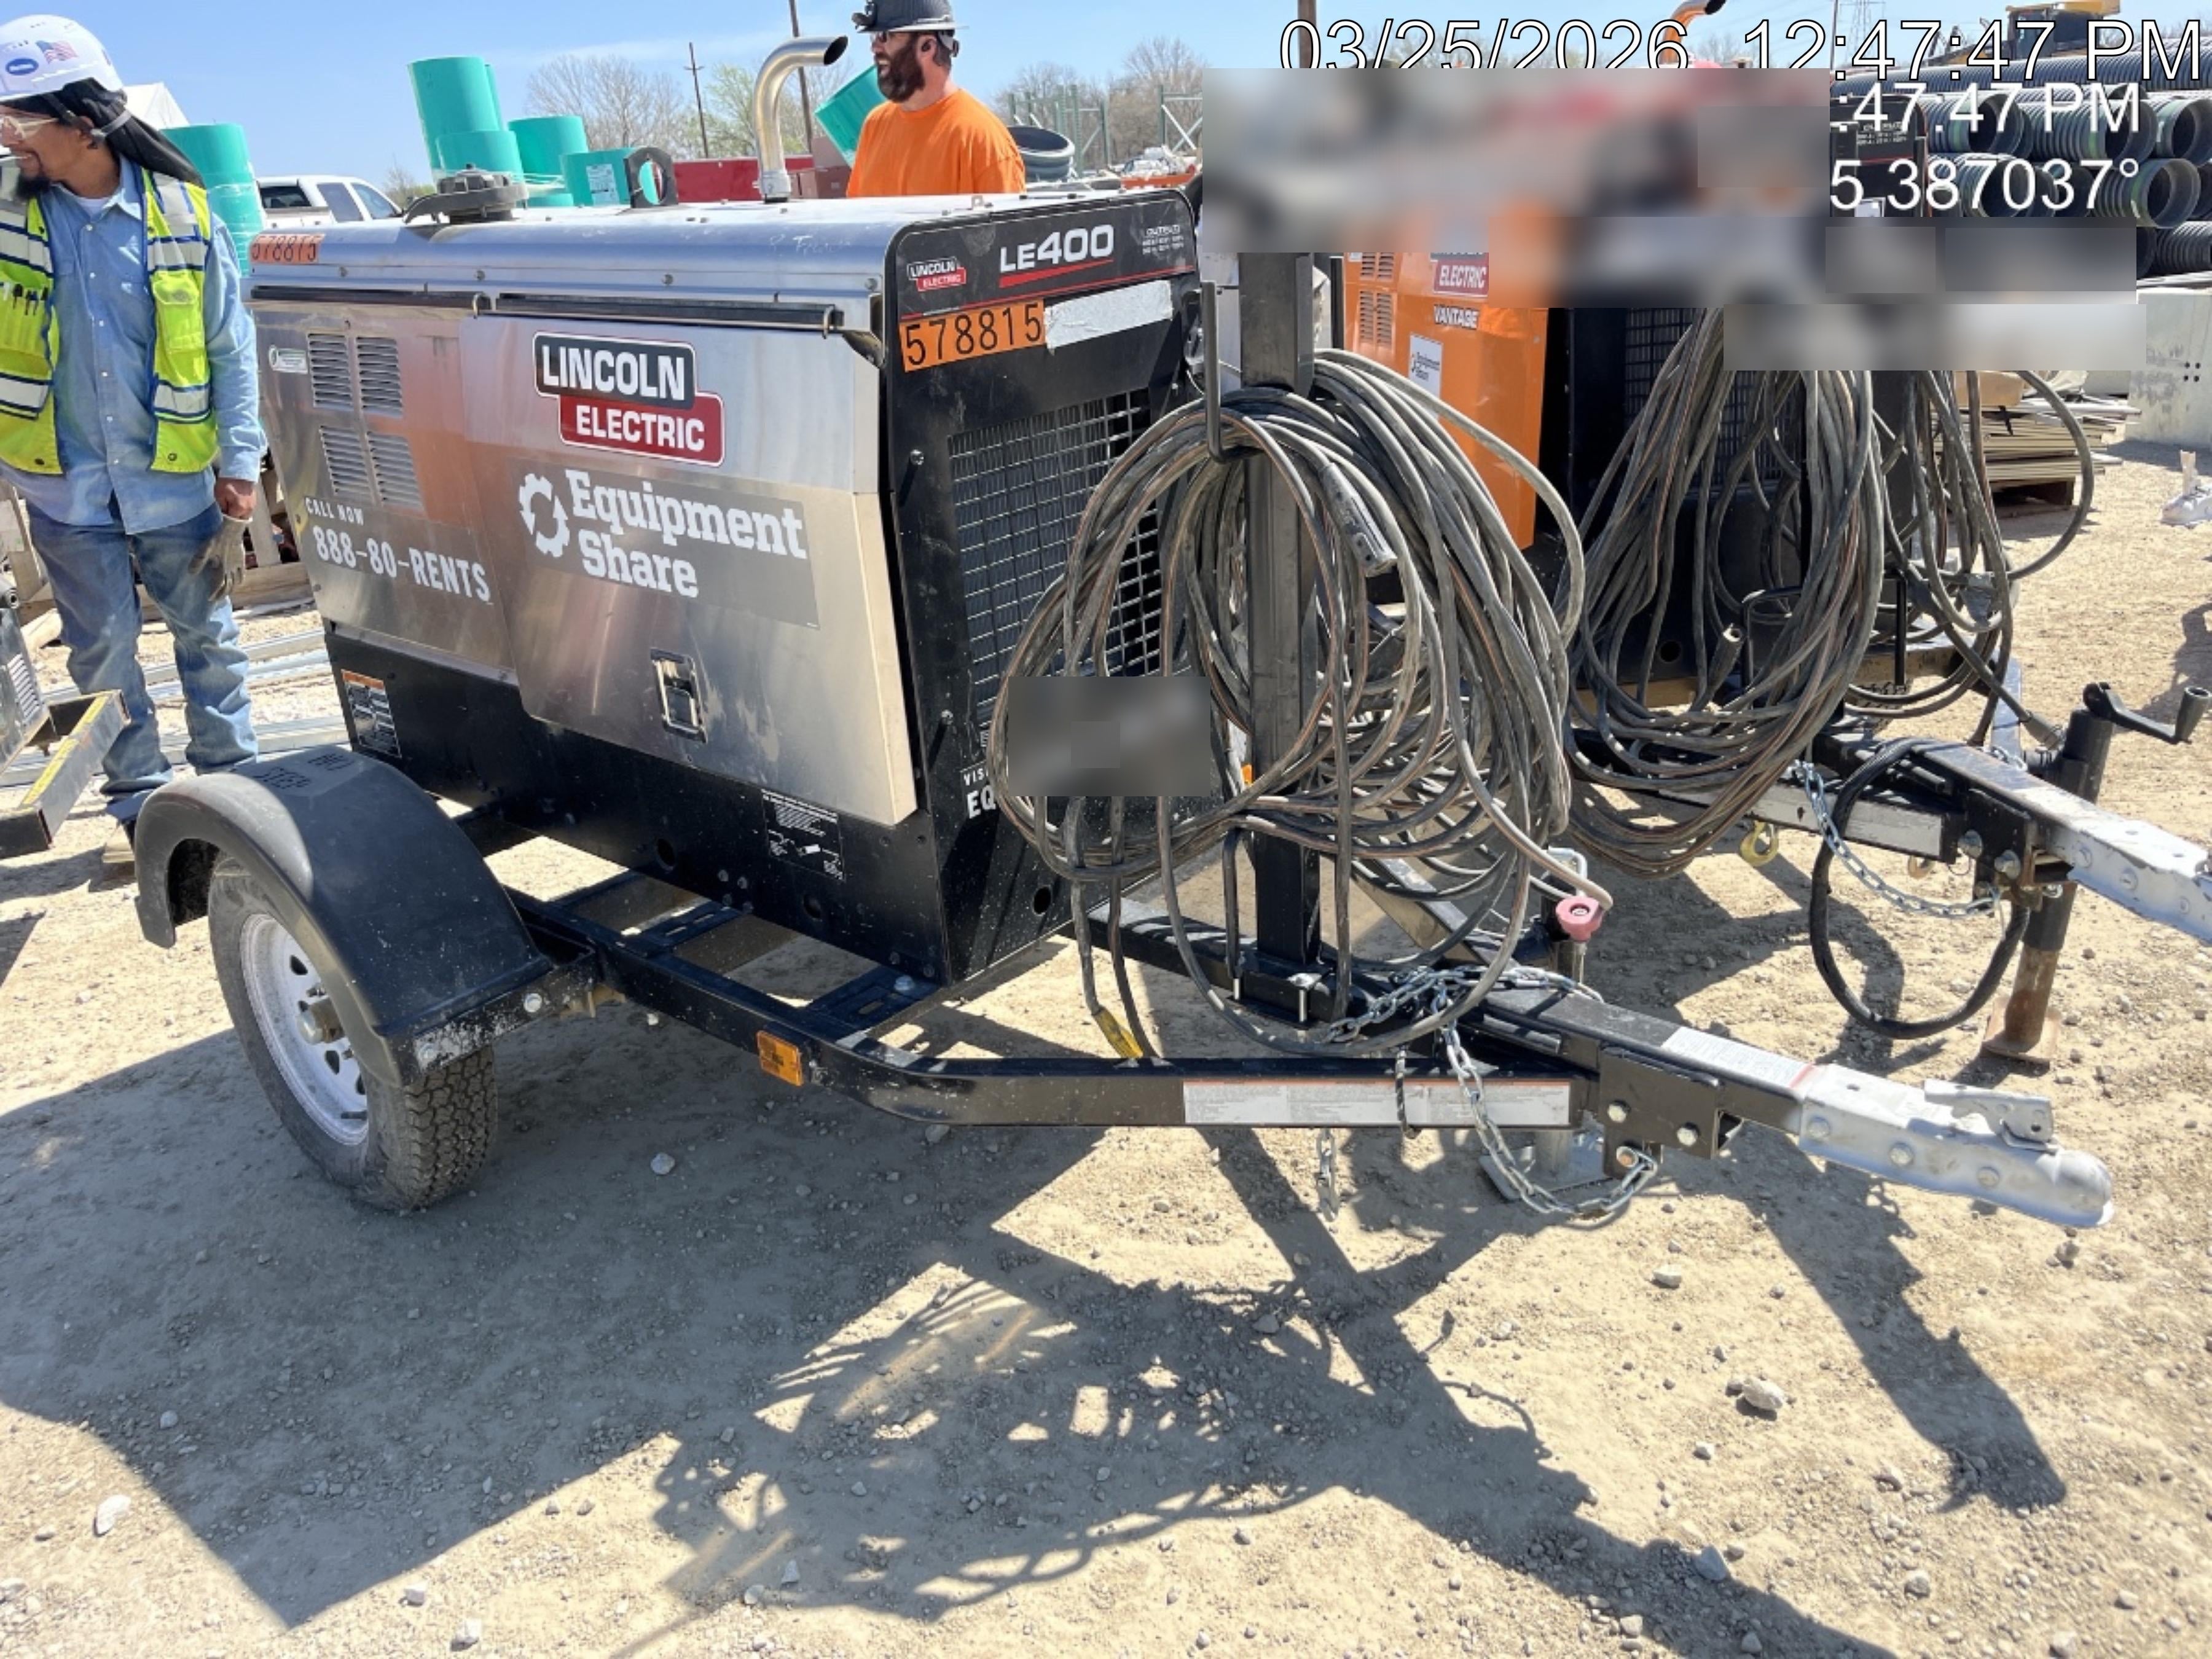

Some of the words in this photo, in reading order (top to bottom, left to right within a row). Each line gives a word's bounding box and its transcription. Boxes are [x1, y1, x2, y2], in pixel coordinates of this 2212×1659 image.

[910, 261, 956, 278] LINCOLN
[999, 223, 1115, 273] LE400
[922, 274, 961, 288] ELECTRIC
[1438, 264, 1487, 289] ELECTRIC
[905, 304, 1041, 366] 578815
[1433, 304, 1480, 330] VANTAGE
[541, 345, 685, 401] LINCOLN
[576, 404, 705, 452] ELECTRIC
[305, 496, 335, 519] CALL
[337, 503, 364, 526] NOW
[565, 468, 807, 559] Equipment
[312, 525, 491, 602] 888-80-RENTS
[578, 528, 699, 598] Share
